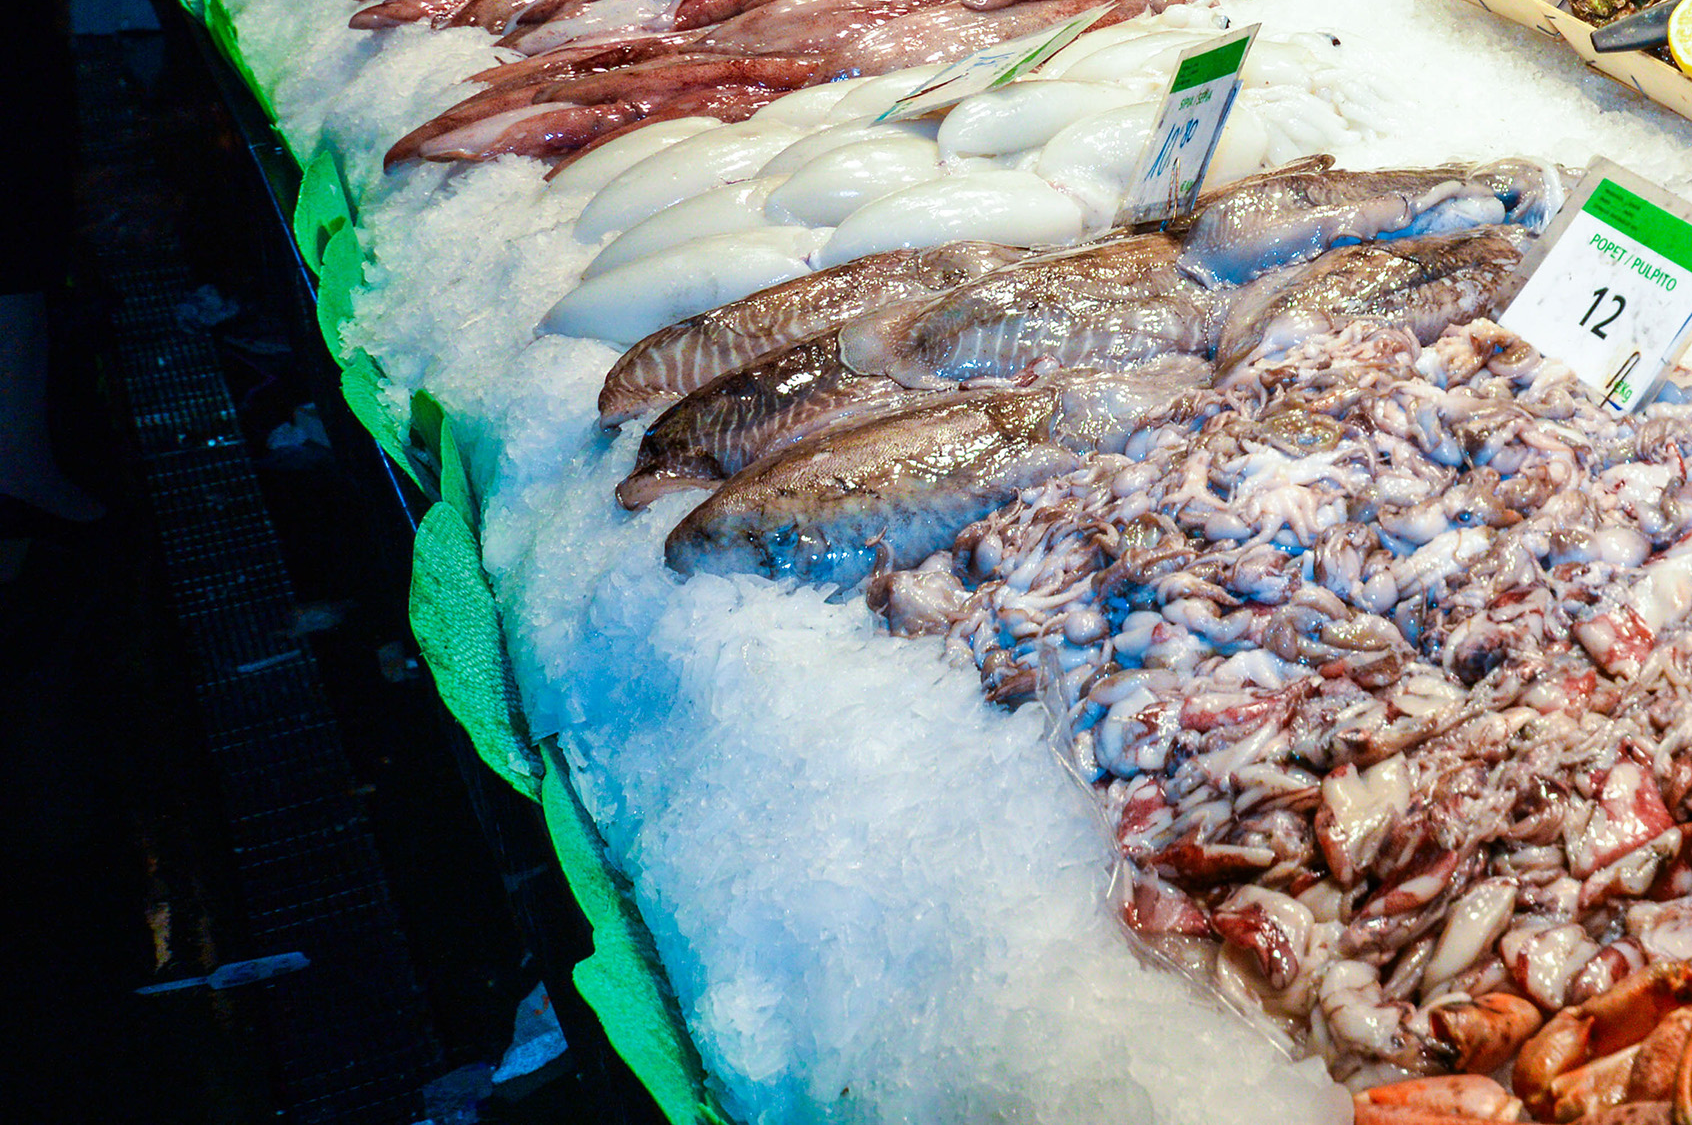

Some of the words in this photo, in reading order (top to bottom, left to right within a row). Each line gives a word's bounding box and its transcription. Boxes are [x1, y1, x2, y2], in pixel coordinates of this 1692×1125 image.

[1589, 232, 1627, 264] POPET
[1631, 258, 1678, 293] PULPITO
[1578, 285, 1627, 341] 12
